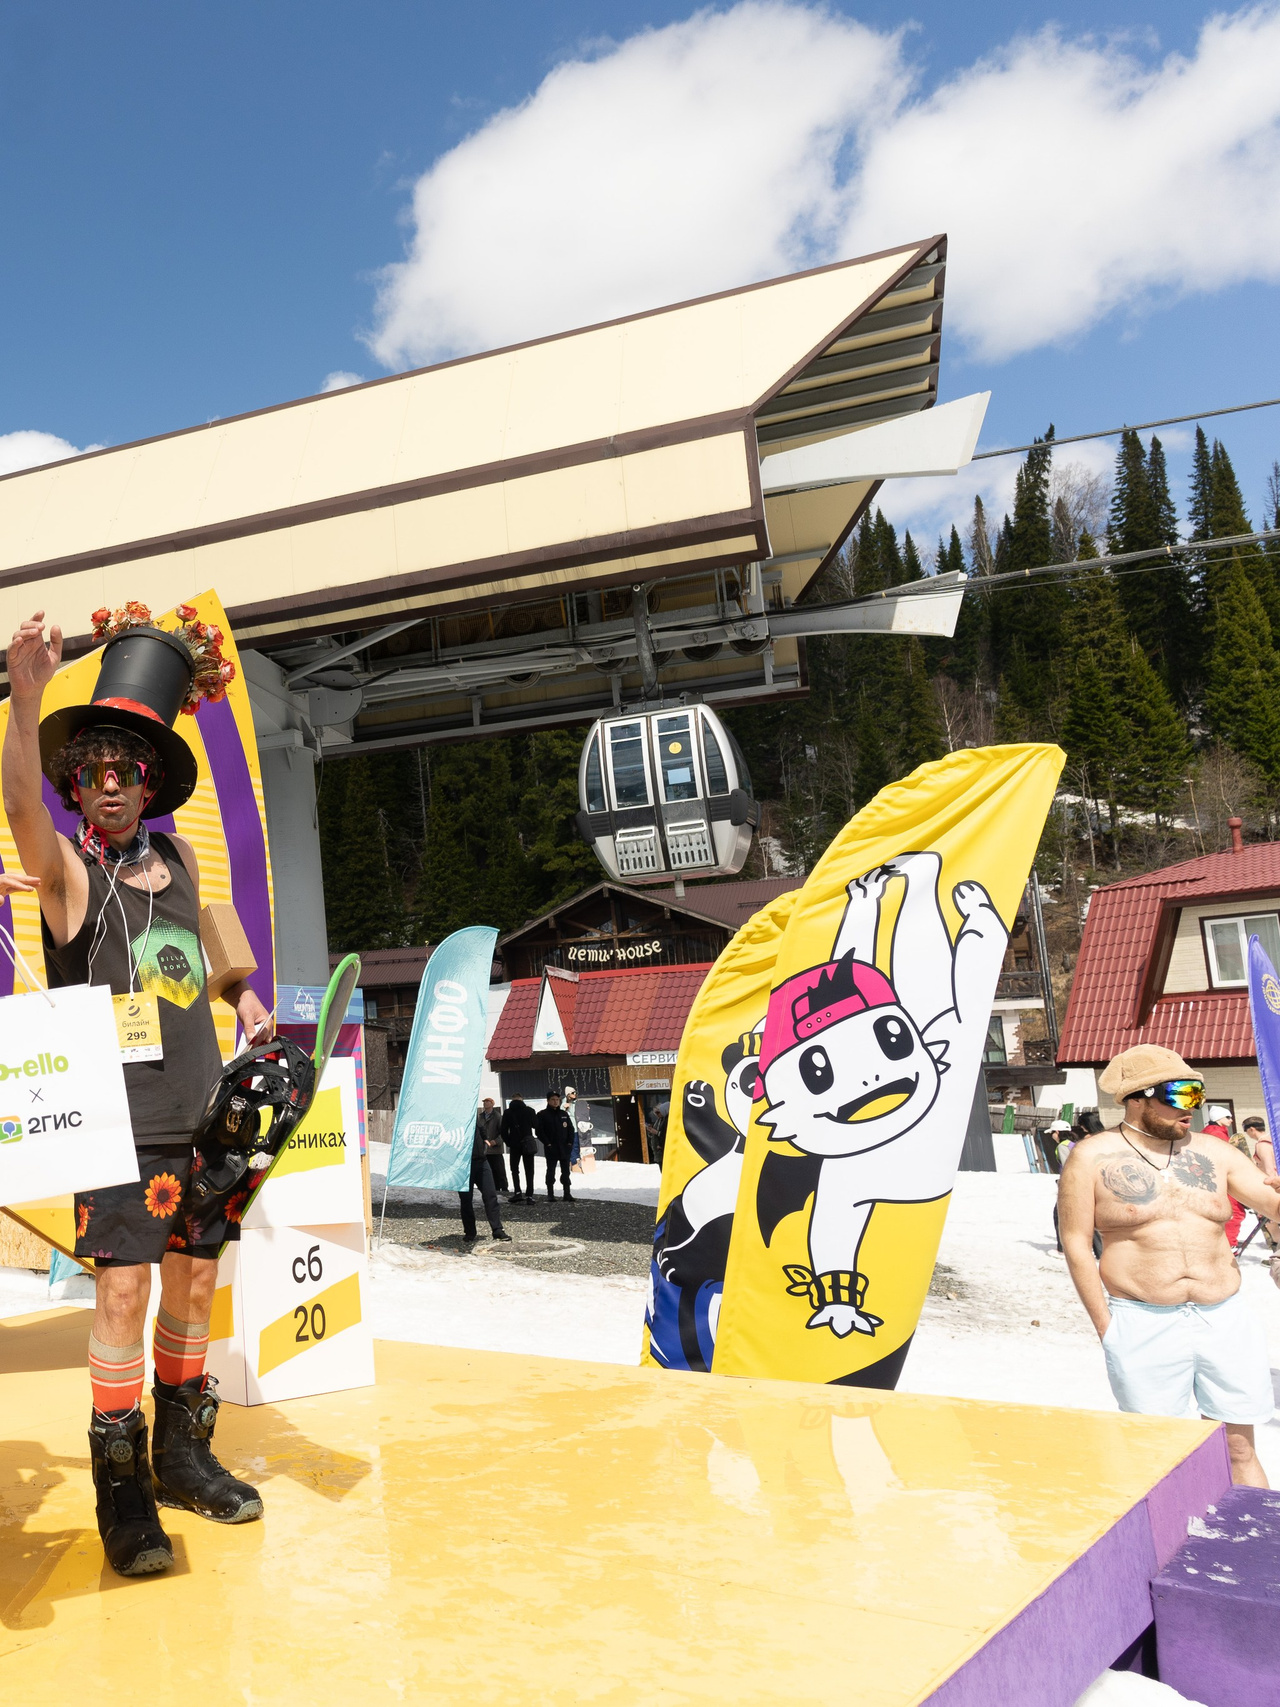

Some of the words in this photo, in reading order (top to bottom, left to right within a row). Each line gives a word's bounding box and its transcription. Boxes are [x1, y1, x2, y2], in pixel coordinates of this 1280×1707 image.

[122, 1020, 150, 1028] билайн
[127, 1031, 147, 1041] 299
[421, 979, 469, 1085] ИНФО
[632, 1053, 678, 1064] СЕРВИ
[27, 1111, 83, 1134] 2ГИС
[409, 1125, 440, 1135] GRELKA
[287, 1132, 347, 1149] ьниках
[408, 1134, 429, 1145] FEST
[292, 1244, 323, 1284] сб
[293, 1303, 326, 1343] 20
